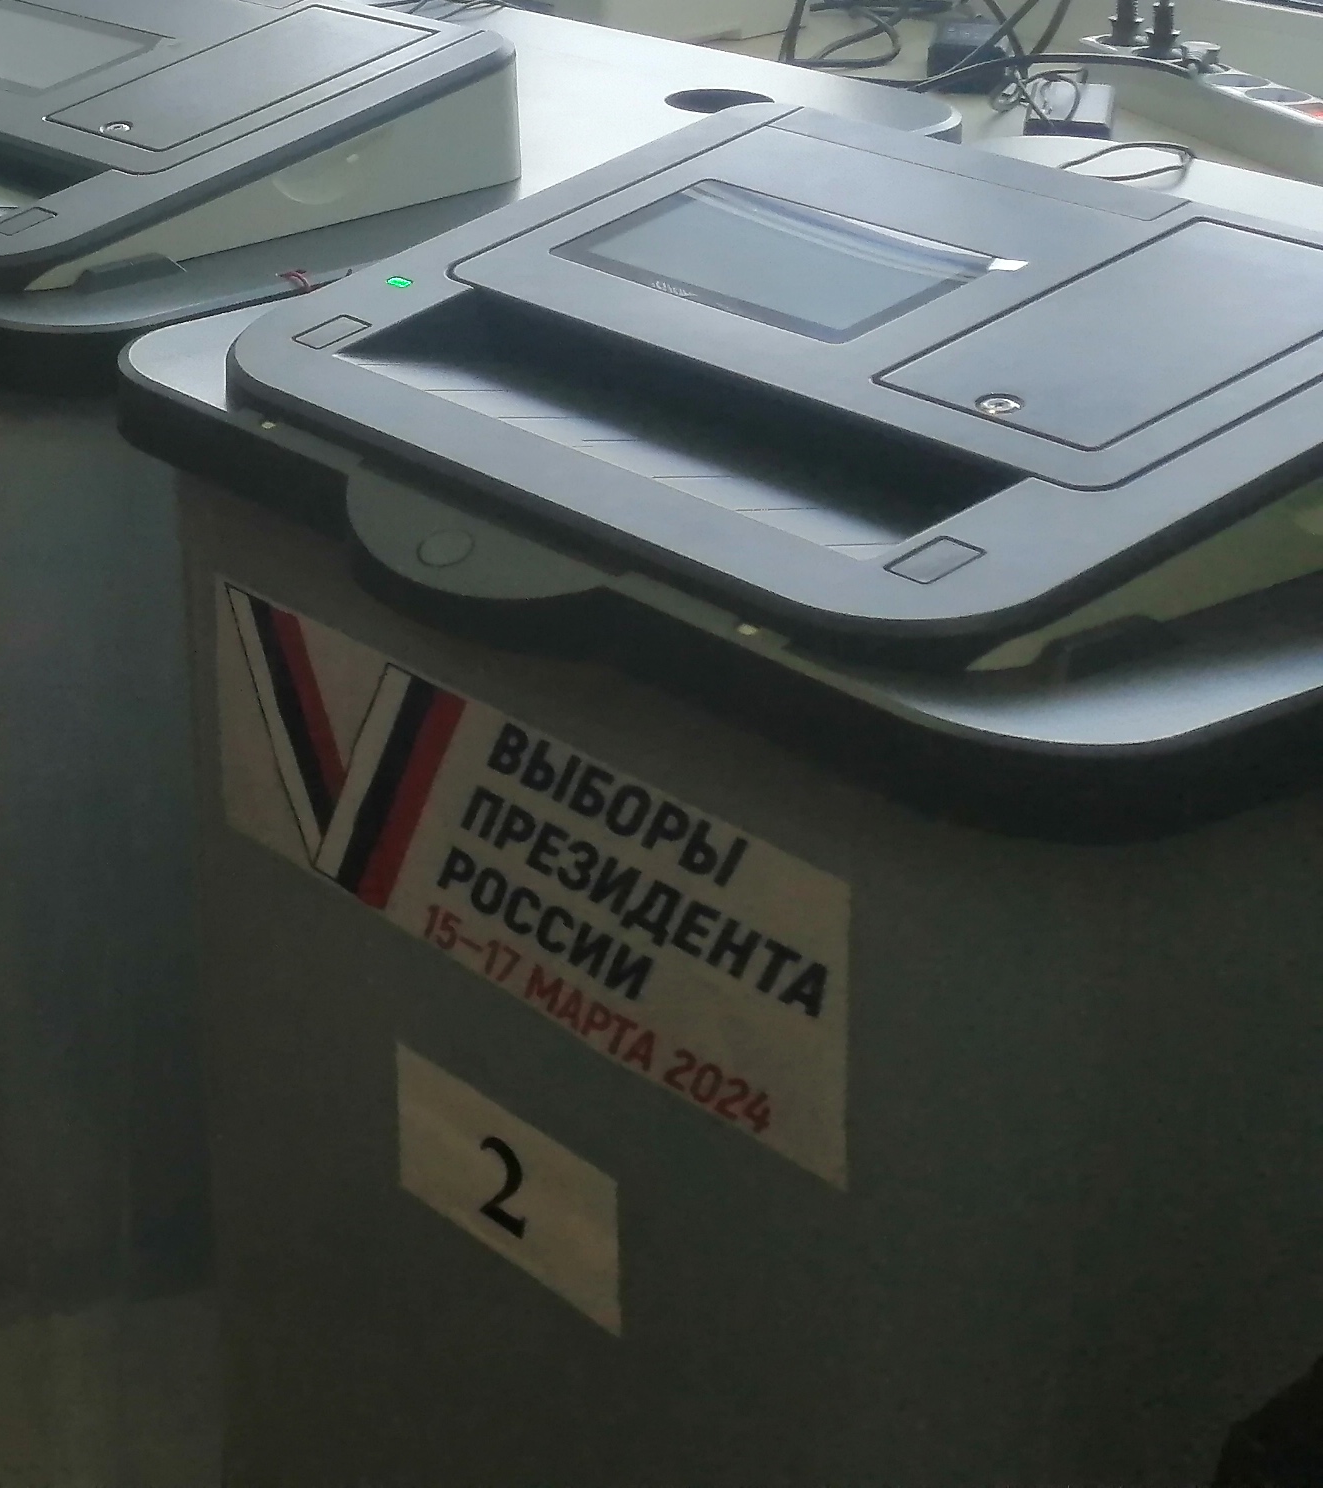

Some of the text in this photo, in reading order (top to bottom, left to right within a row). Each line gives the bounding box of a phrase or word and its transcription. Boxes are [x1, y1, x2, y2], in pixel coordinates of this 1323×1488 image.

[486, 721, 750, 888] ВЫБОРЫ
[435, 846, 654, 1001] РОССИИ
[459, 785, 832, 1018] ПРЕЗИДЕНТА
[524, 962, 653, 1072] МАРТА
[663, 1048, 775, 1135] 2024
[479, 1135, 526, 1240] 2
